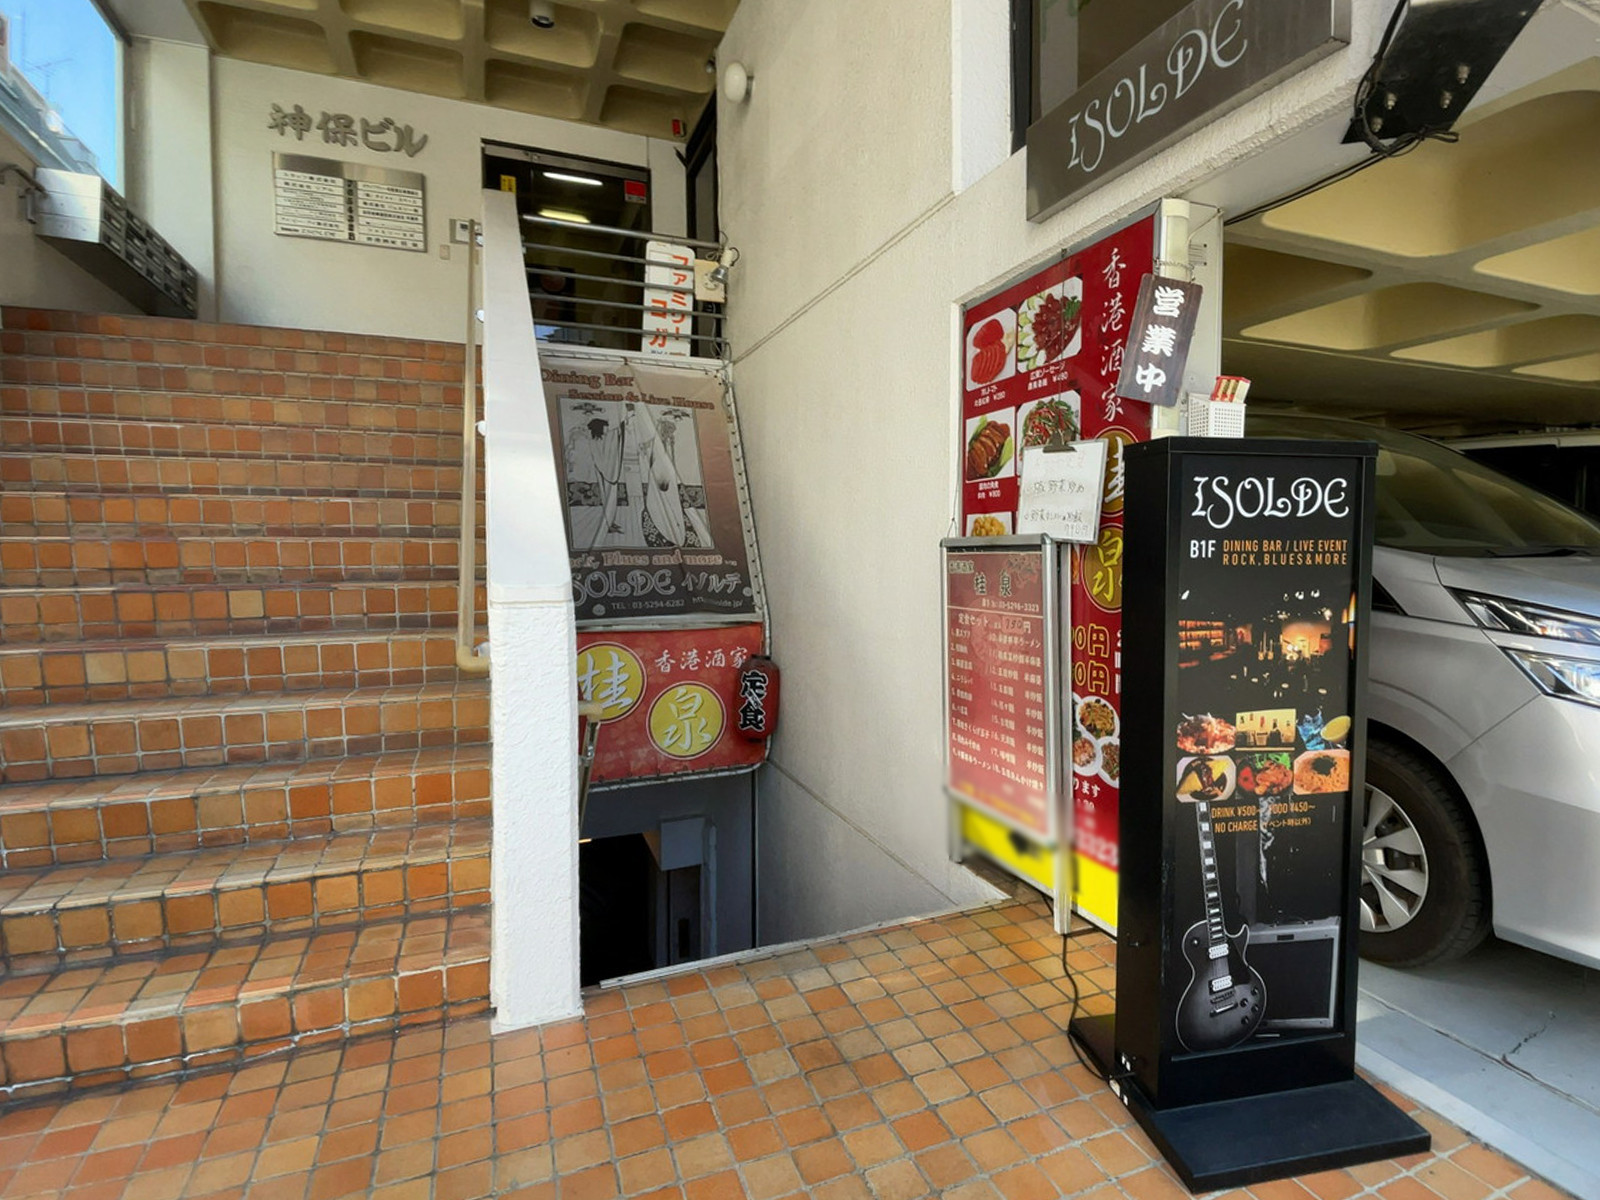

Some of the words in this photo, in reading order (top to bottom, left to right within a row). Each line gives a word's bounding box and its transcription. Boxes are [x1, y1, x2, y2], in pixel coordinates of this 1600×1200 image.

[1067, 0, 1248, 173] ISOLDE
[268, 103, 428, 158] 神保ビル
[1101, 247, 1126, 422] 香港酒家
[1135, 285, 1185, 393] 営業中
[541, 368, 601, 389] Dining
[603, 373, 634, 387] Bar
[568, 389, 624, 402] Session
[625, 391, 639, 402] &
[640, 392, 671, 406] Live
[672, 396, 716, 410] House
[1191, 476, 1349, 529] ISOLDE
[570, 554, 599, 569] ock,
[602, 551, 649, 566] Blues
[652, 549, 683, 565] and
[1190, 539, 1216, 558] B1F
[1223, 539, 1259, 552] DINING
[1263, 539, 1282, 552] BAR
[1294, 540, 1314, 552] LIVE
[1318, 540, 1348, 552] EVENT
[572, 569, 676, 607] SOLDE
[655, 647, 748, 674] 香港酒家
[577, 651, 633, 709] 桂
[663, 686, 713, 750] 泉
[739, 670, 768, 731] 定食
[1211, 806, 1236, 819] DRINK
[1214, 822, 1226, 833] NO
[1228, 820, 1258, 832] CHARGE
